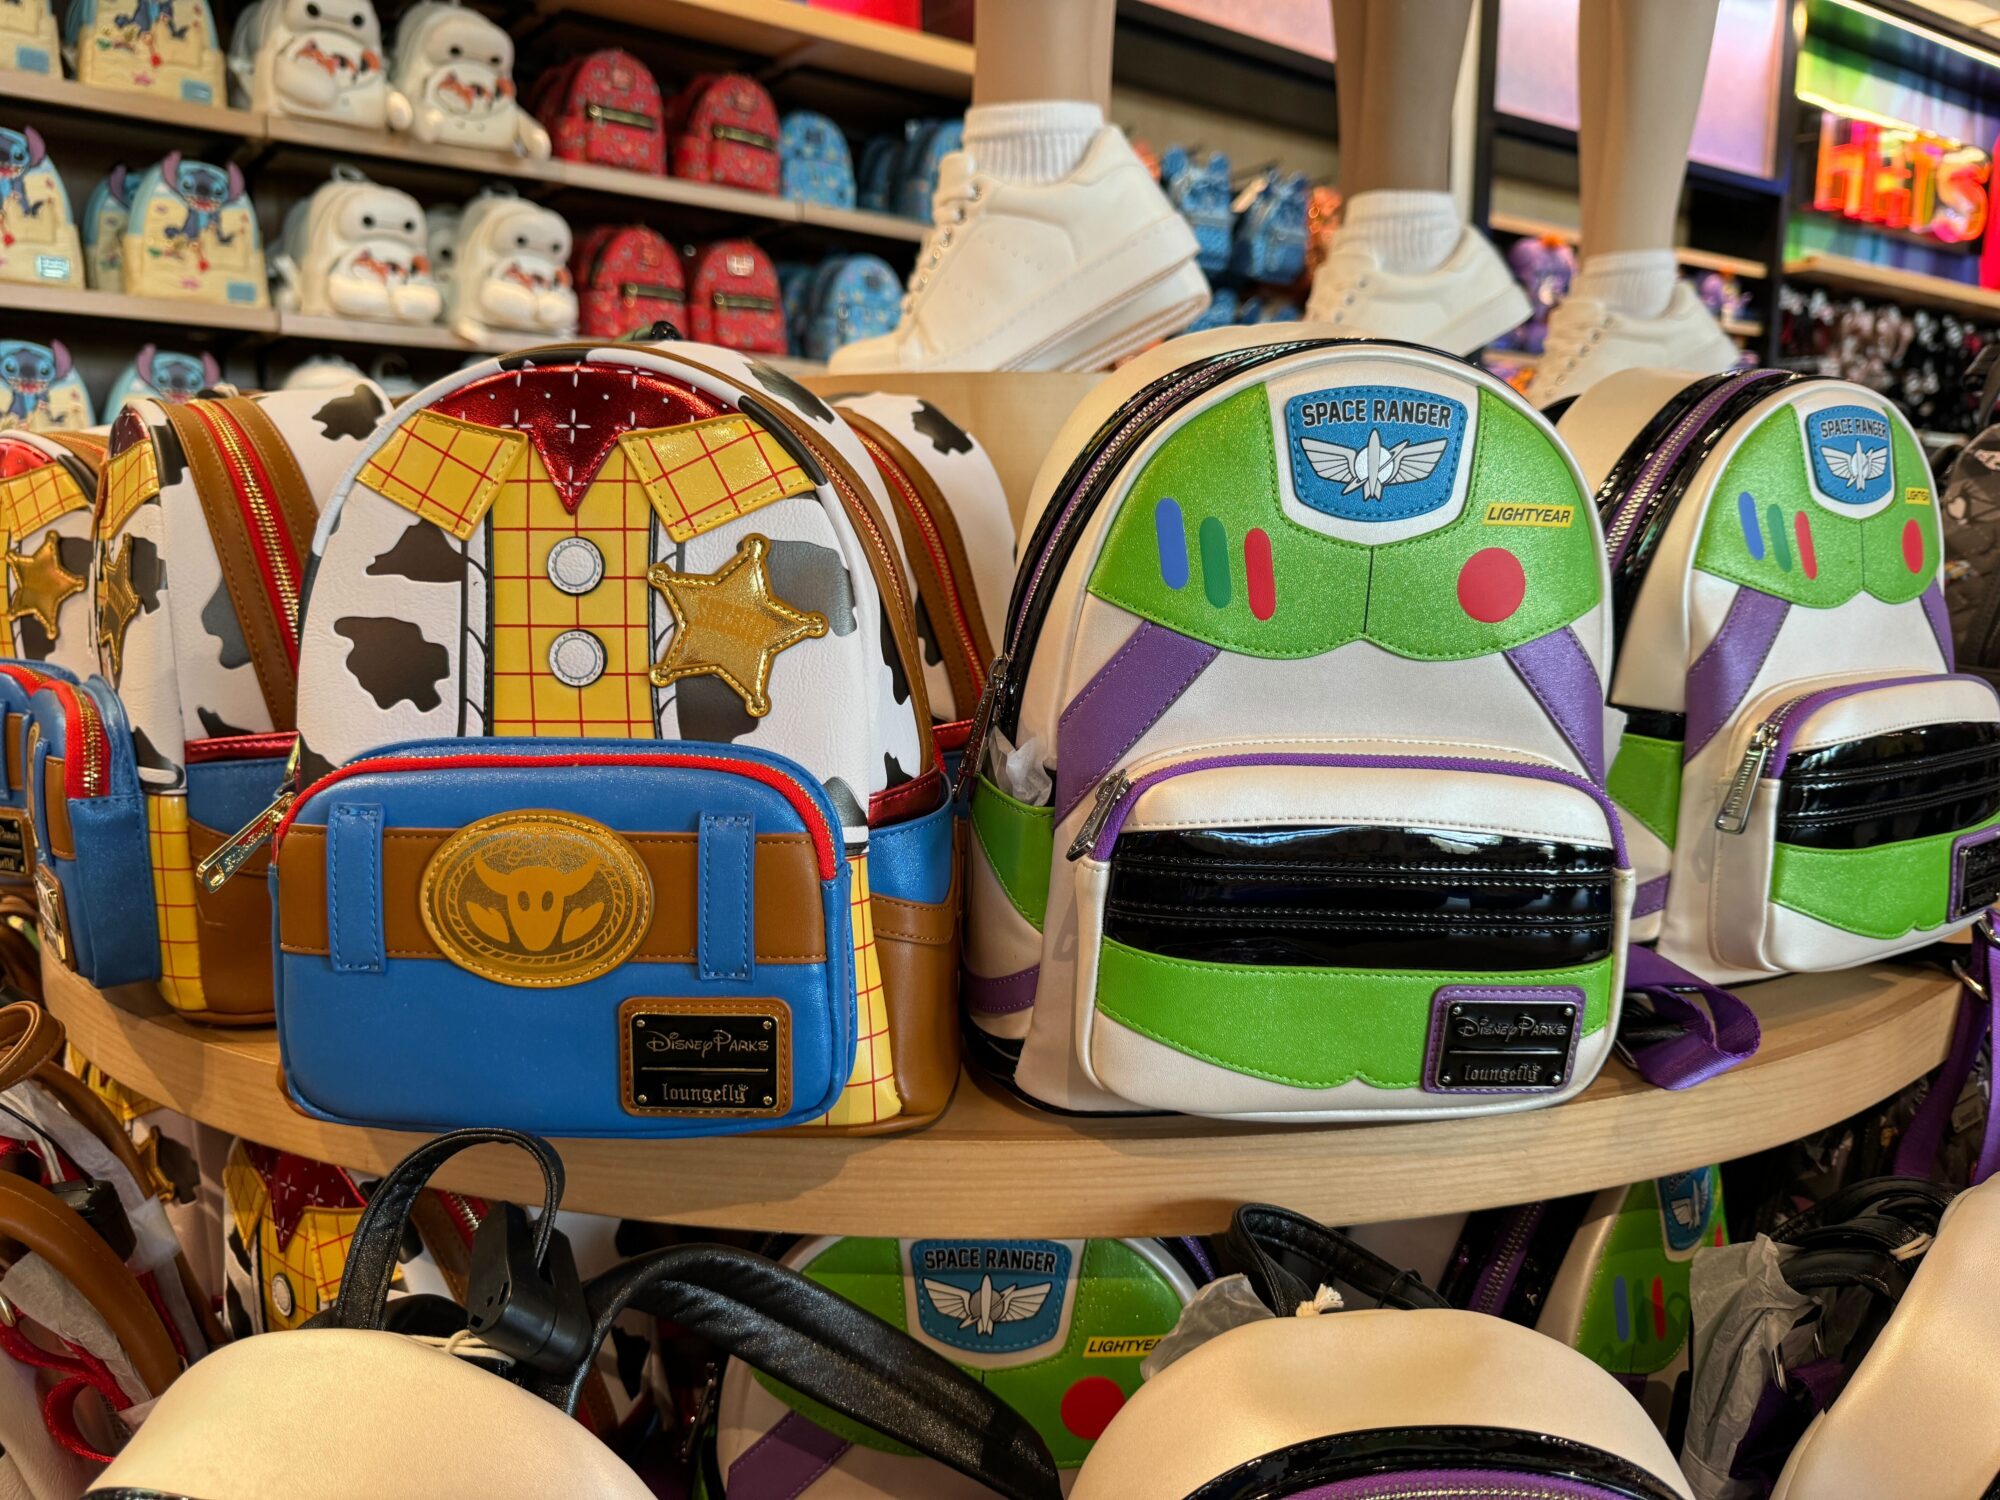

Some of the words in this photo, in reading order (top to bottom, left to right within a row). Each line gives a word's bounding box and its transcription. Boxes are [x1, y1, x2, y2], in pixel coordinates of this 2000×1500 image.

[1302, 399, 1366, 427] SPACE
[1373, 399, 1451, 428] RANGER
[1820, 417, 1853, 438] SPACE
[1487, 507, 1571, 523] LIGHTYEAR
[1464, 1064, 1541, 1083] loungefly
[662, 1083, 748, 1104] loungefly
[924, 1247, 980, 1270] SPACE
[985, 1247, 1057, 1273] RANGER
[1088, 1338, 1162, 1353] LIGHTYE
